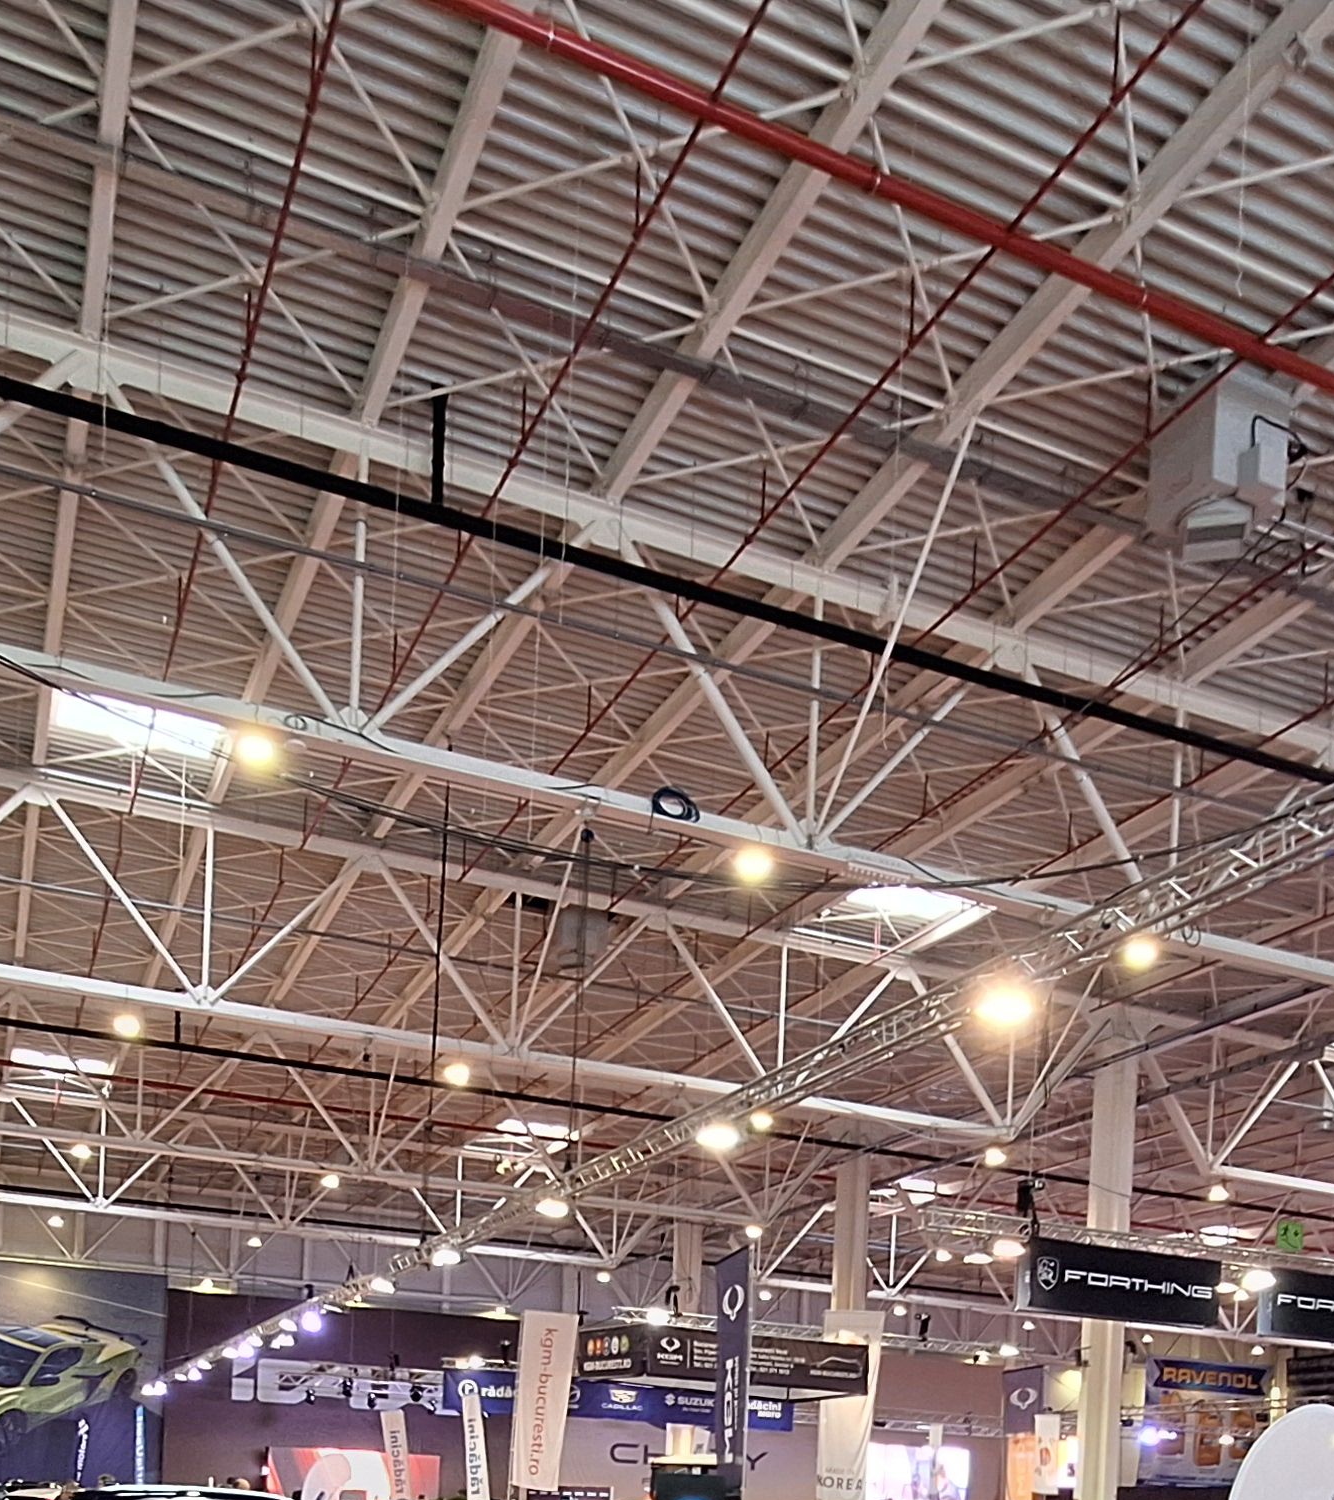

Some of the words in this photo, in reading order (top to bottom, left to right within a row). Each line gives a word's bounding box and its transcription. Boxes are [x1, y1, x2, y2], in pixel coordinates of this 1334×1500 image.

[1063, 1268, 1213, 1300] FORTHING
[1162, 1366, 1259, 1389] RAVENOL
[527, 1327, 559, 1477] kgm-bucuresti.ro
[677, 1395, 715, 1408] SUZUK
